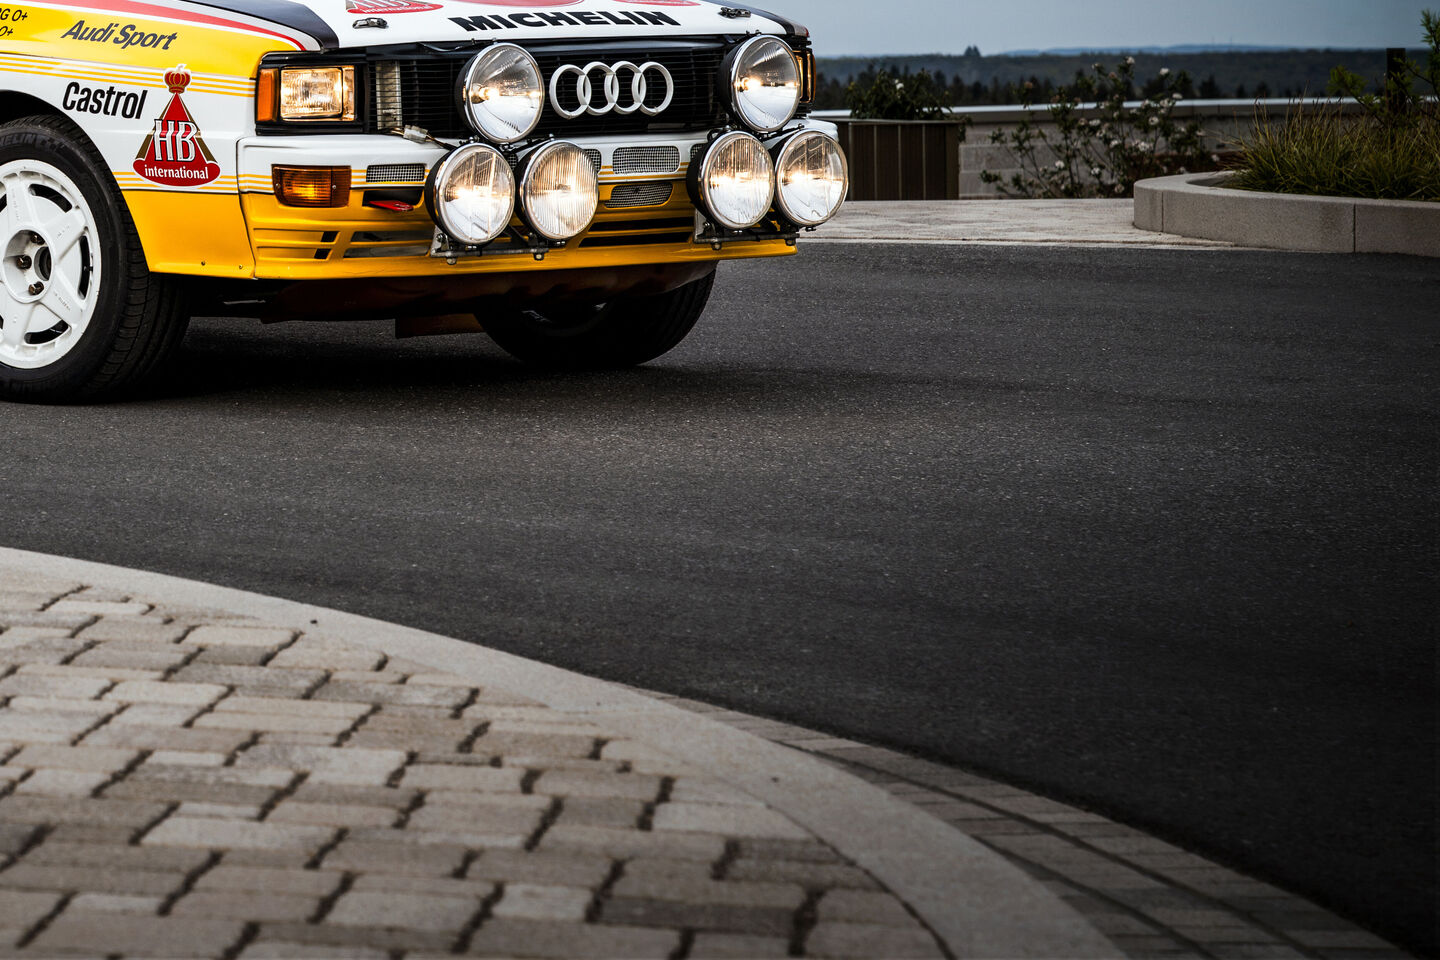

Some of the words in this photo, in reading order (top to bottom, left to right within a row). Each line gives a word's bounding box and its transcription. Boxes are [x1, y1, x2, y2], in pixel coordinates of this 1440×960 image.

[61, 20, 119, 43] Audi
[112, 23, 178, 50] Sport
[448, 10, 682, 32] MICHELIN
[62, 81, 148, 120] Castrol
[152, 119, 198, 163] HB
[144, 164, 209, 181] international
